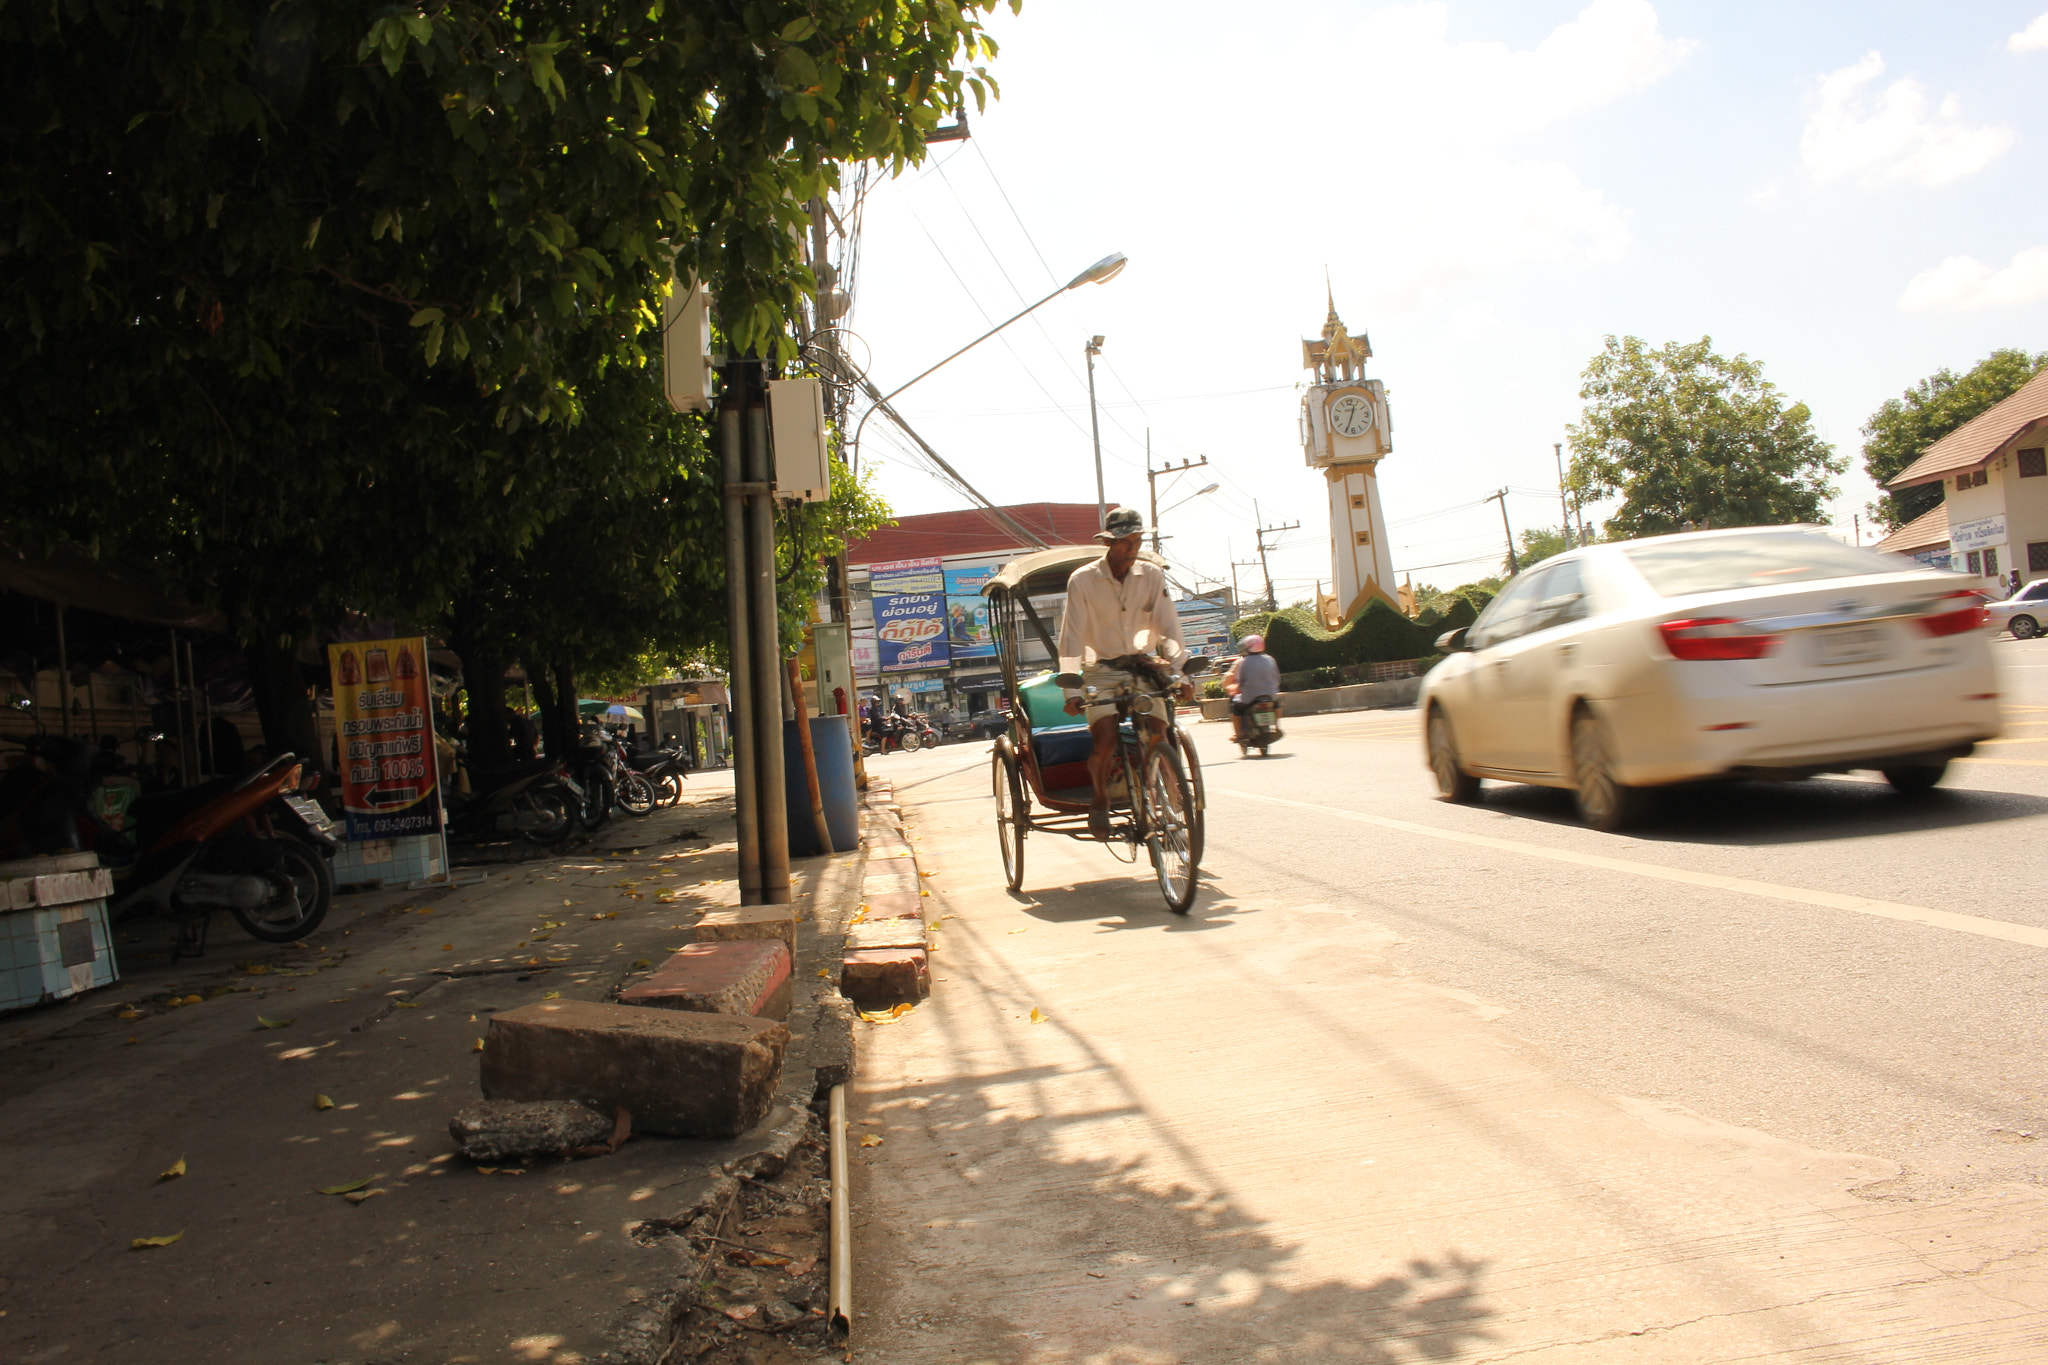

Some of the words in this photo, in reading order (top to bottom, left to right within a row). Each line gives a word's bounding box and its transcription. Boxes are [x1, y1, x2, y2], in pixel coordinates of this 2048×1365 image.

[881, 602, 938, 617] ผ่อนอยู่
[888, 594, 931, 606] รถยง
[882, 617, 943, 643] ก็กู้ได้
[897, 642, 932, 661] การันตี
[889, 681, 925, 691] กรบรูป
[358, 687, 404, 709] รับเลี่ยม
[343, 707, 424, 735] กรอบพระกันน้ำ
[348, 735, 422, 759] มีปัญหาแก้ฟรี
[351, 759, 380, 783] กันน้ำ
[383, 758, 425, 780] 100%
[354, 819, 371, 834] โทร.
[374, 815, 432, 832] 093-2407314
